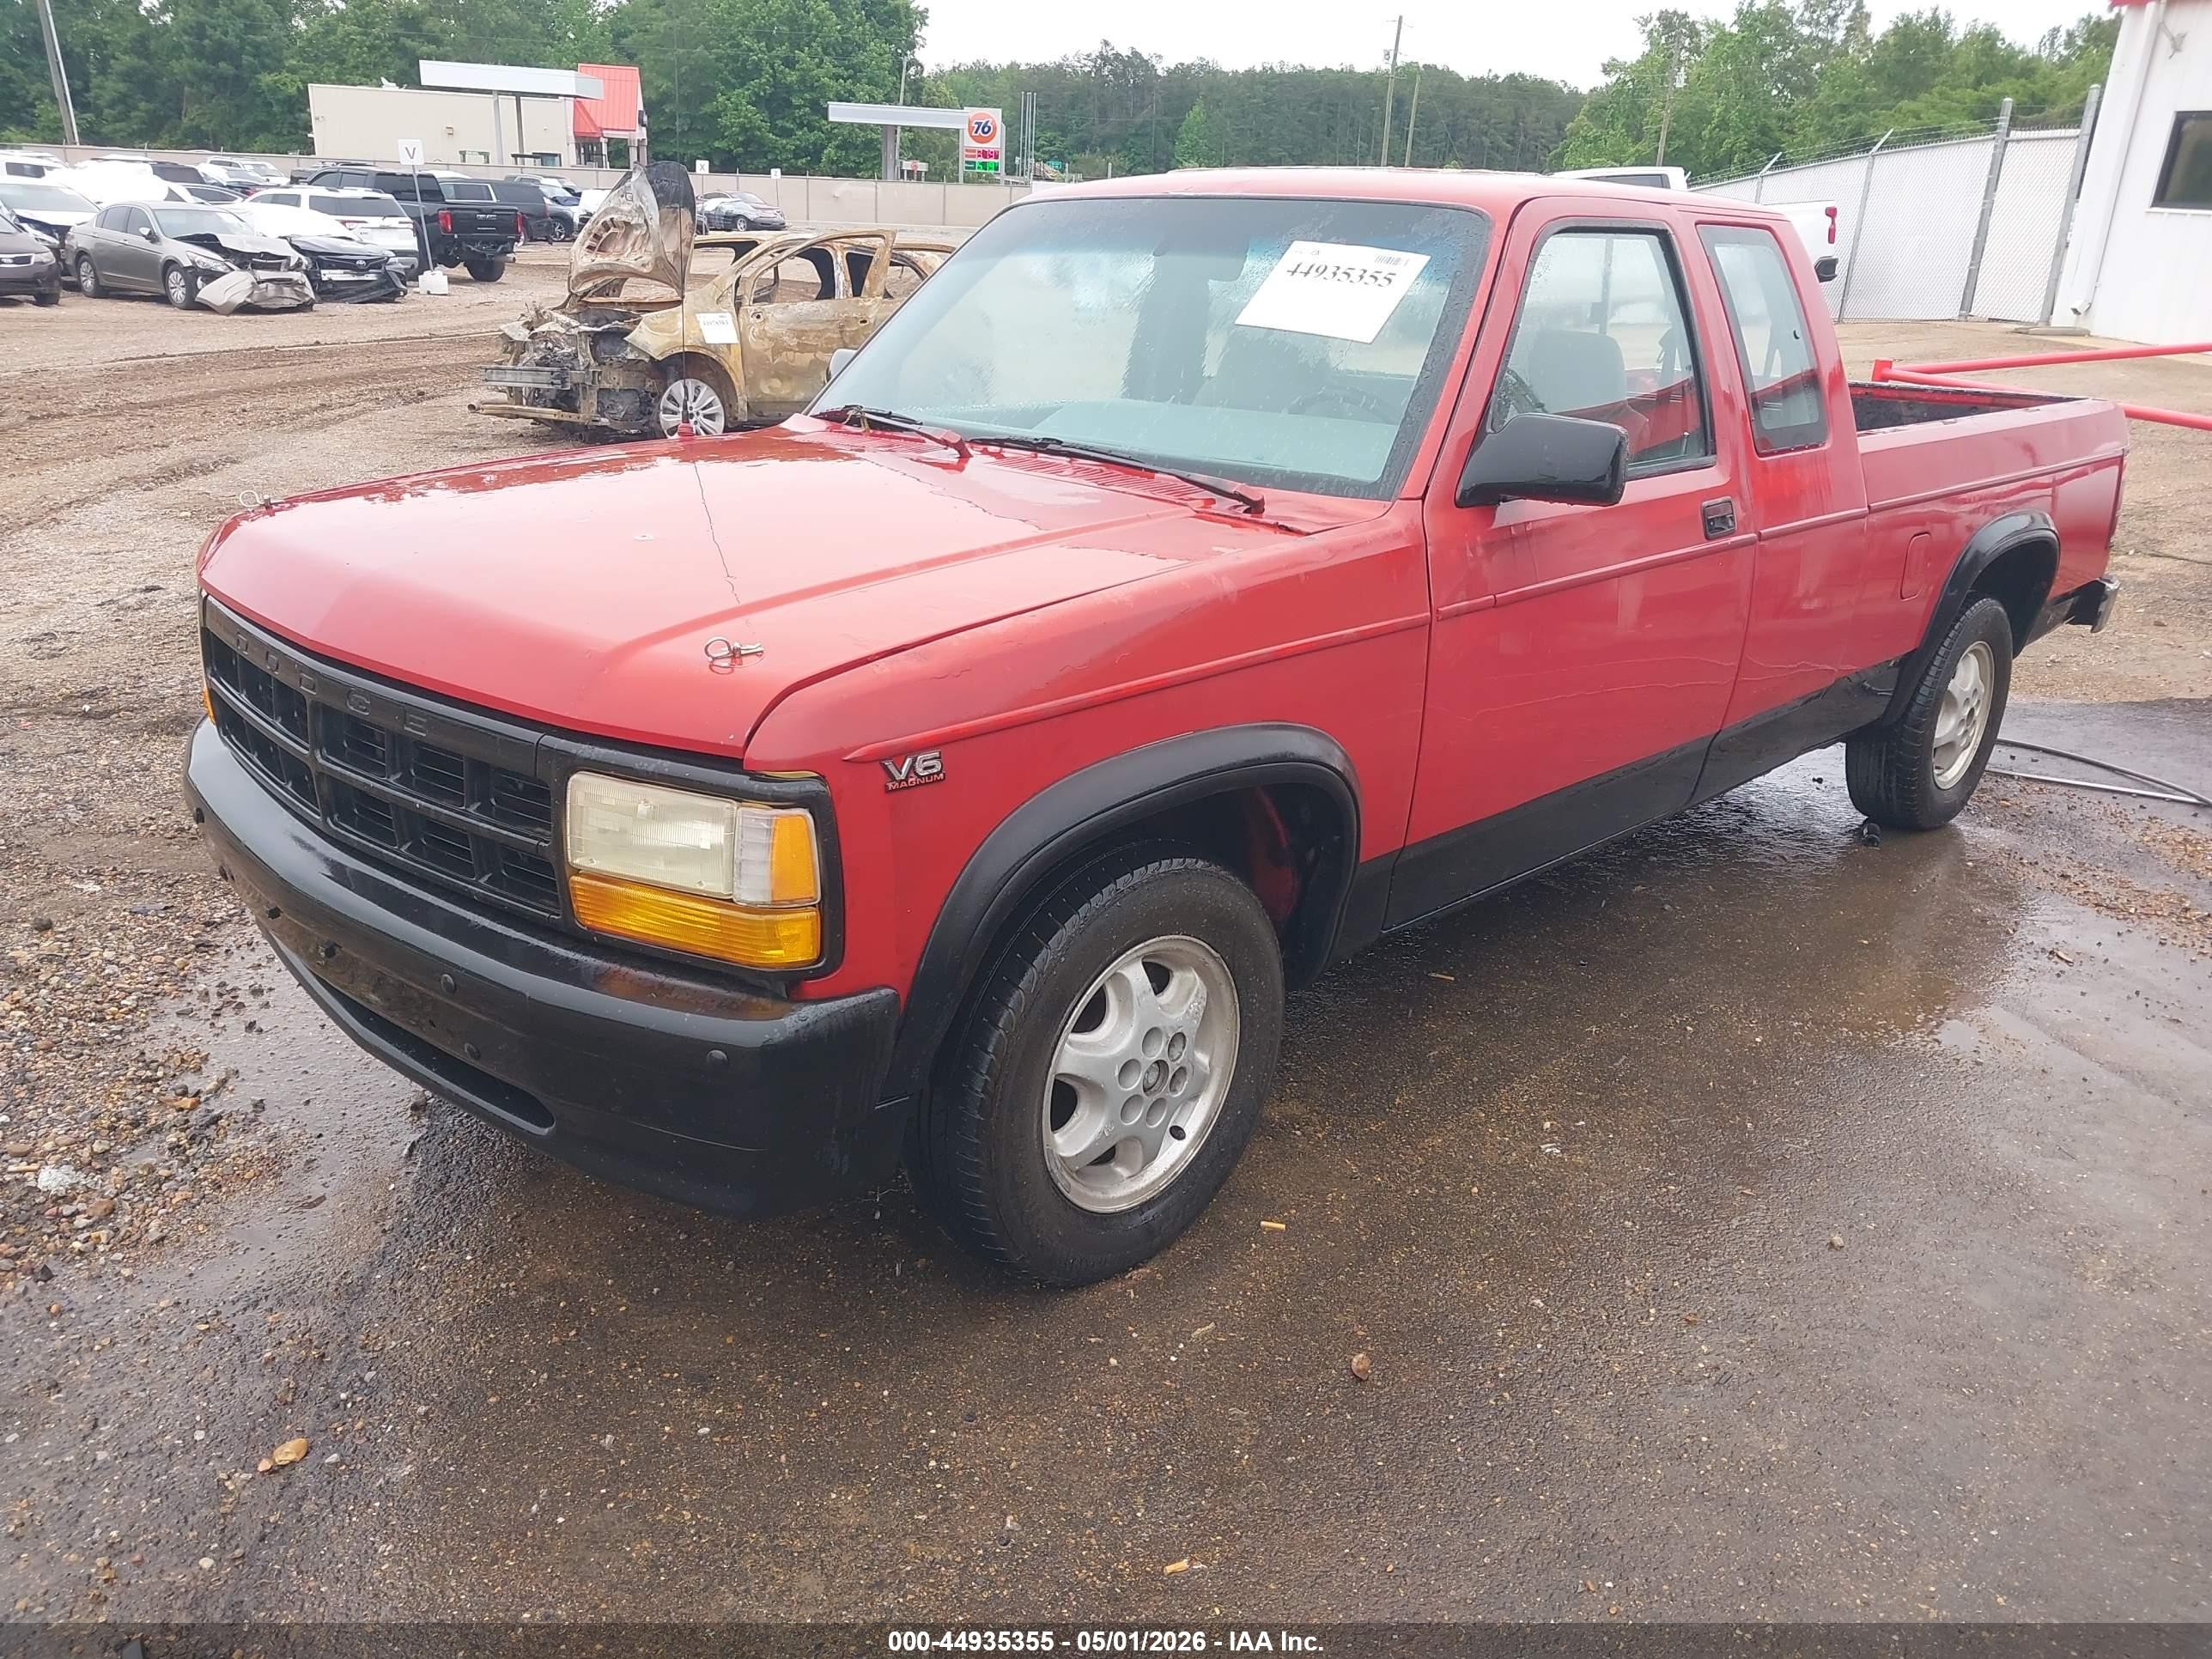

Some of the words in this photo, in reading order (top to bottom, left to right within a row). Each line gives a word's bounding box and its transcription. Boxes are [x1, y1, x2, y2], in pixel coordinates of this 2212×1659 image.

[972, 119, 993, 136] 76
[404, 146, 416, 160] V
[699, 163, 706, 172] X
[1286, 261, 1397, 288] 44935355
[236, 633, 428, 737] DODGE
[882, 751, 942, 781] V6
[886, 773, 945, 790] MAGNUM
